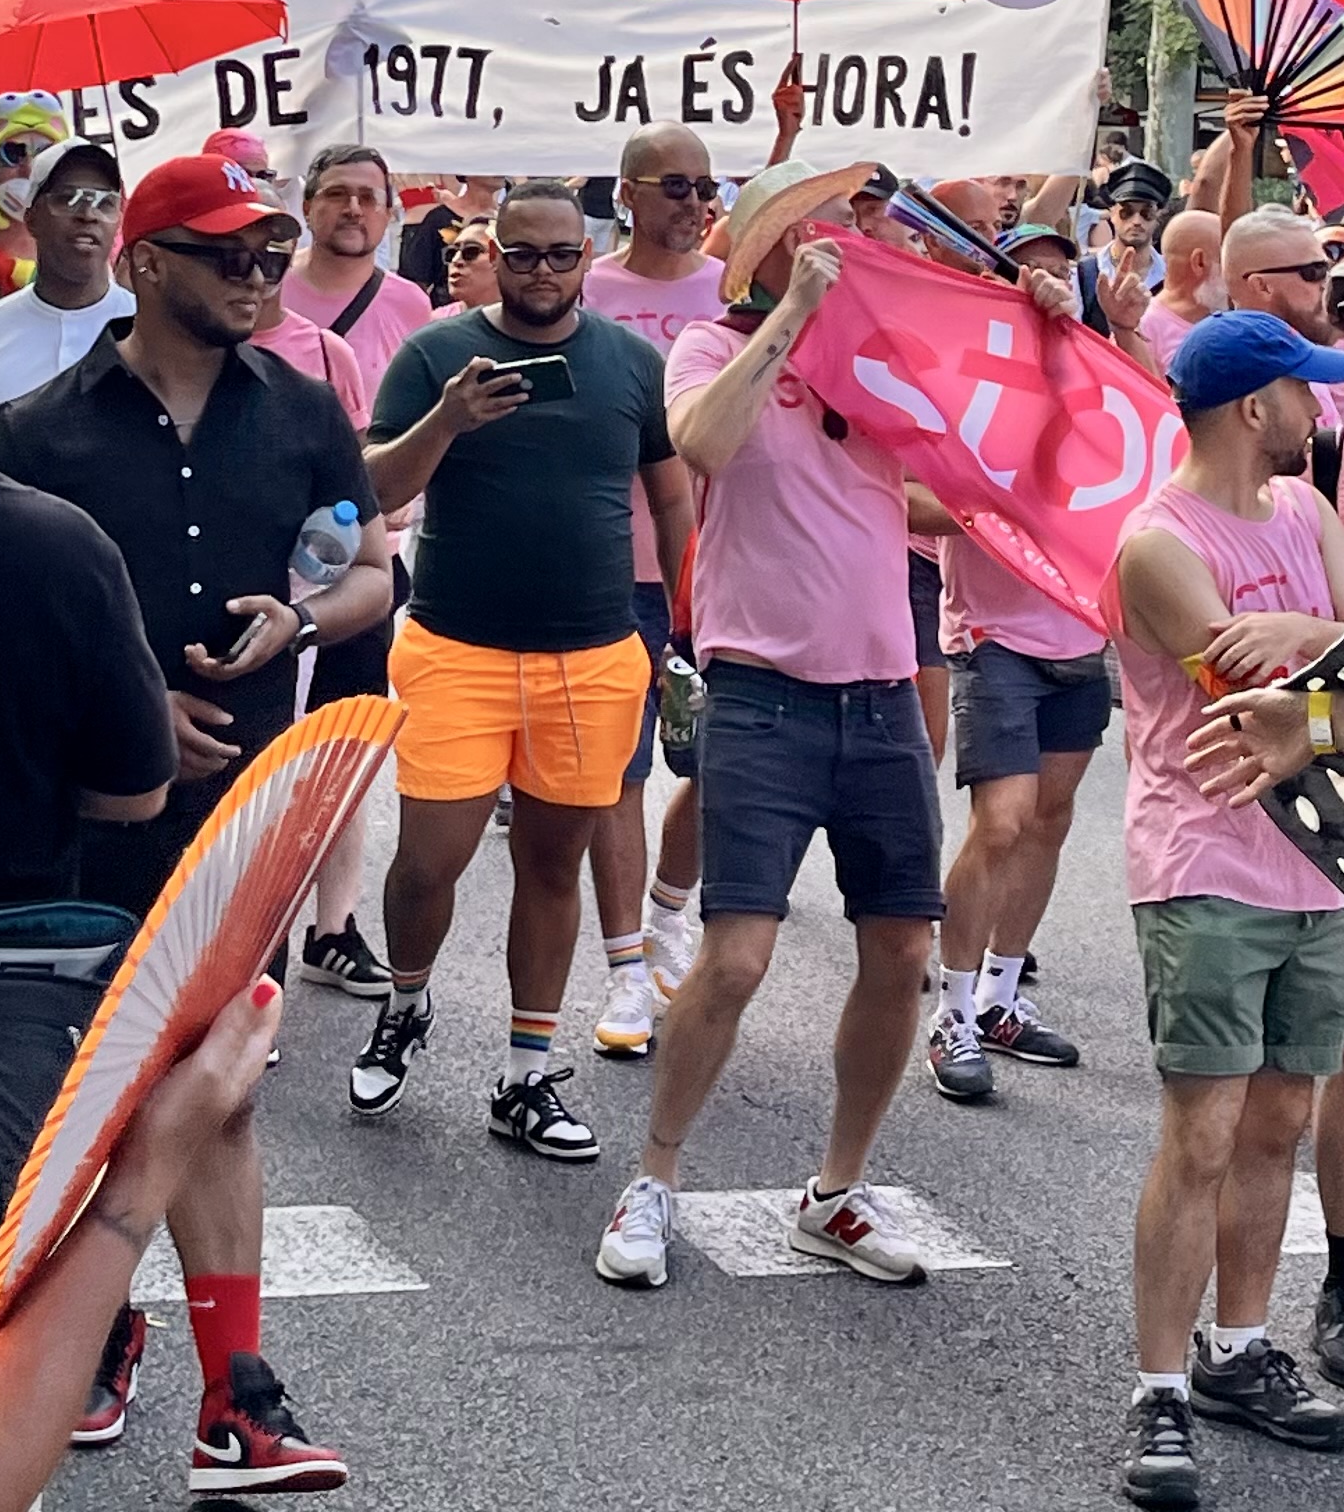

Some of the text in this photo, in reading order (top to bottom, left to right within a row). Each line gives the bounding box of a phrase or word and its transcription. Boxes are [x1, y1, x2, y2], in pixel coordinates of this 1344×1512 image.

[58, 74, 160, 145] ES
[215, 48, 308, 129] DE
[363, 42, 504, 130] 1977,
[574, 54, 652, 125] JA
[681, 36, 755, 124] ÉS
[792, 52, 977, 138] HORA!
